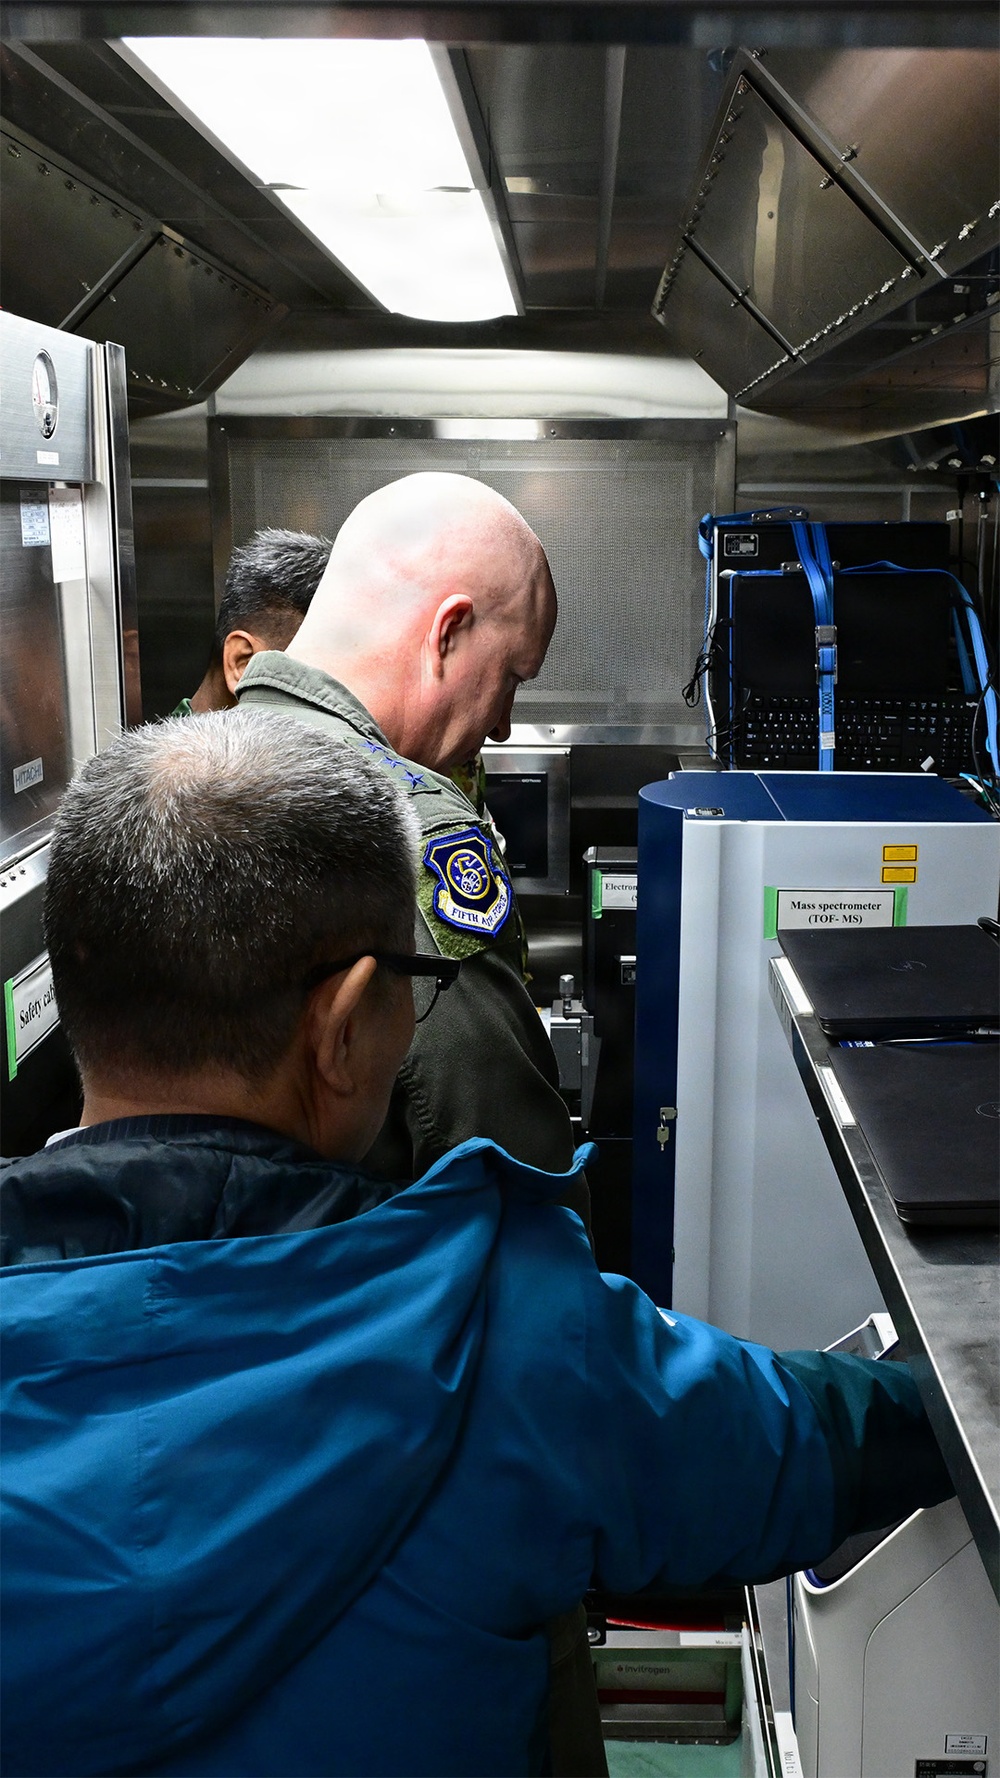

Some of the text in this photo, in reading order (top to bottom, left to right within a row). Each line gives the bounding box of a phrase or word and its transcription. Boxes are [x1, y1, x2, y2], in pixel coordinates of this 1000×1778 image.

[15, 764, 42, 788] HITACHI
[451, 894, 507, 927] FIFTH AIR FORCE
[791, 901, 882, 912] Mass spectrometer
[808, 914, 863, 924] (TOF- MS)
[19, 998, 42, 1029] Safety
[624, 1665, 671, 1675] invitrogen
